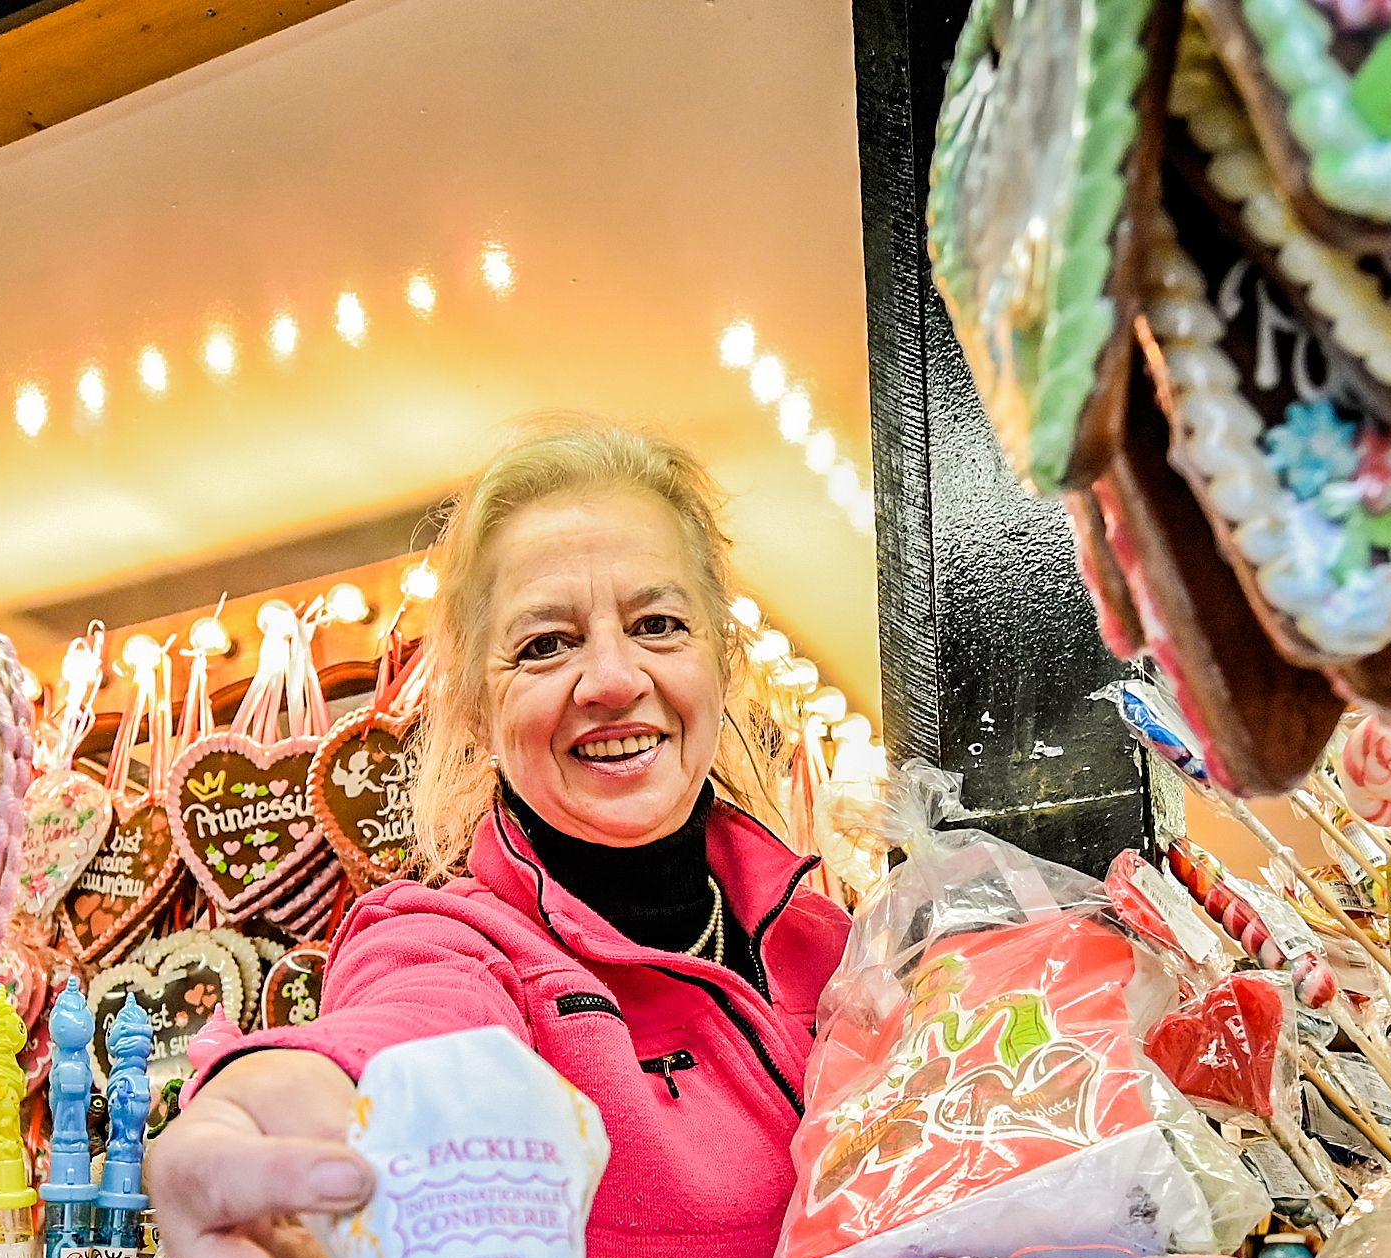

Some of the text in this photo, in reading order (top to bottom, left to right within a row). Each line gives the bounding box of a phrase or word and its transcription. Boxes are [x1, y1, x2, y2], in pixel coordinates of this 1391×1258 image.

[381, 752, 416, 781] Ic
[182, 786, 314, 838] Prinzessi
[110, 826, 144, 853] bist
[78, 872, 145, 902] aumfrau
[147, 1003, 173, 1031] ist
[427, 1135, 564, 1168] FACKLER
[411, 1205, 565, 1240] CONFISERIE
